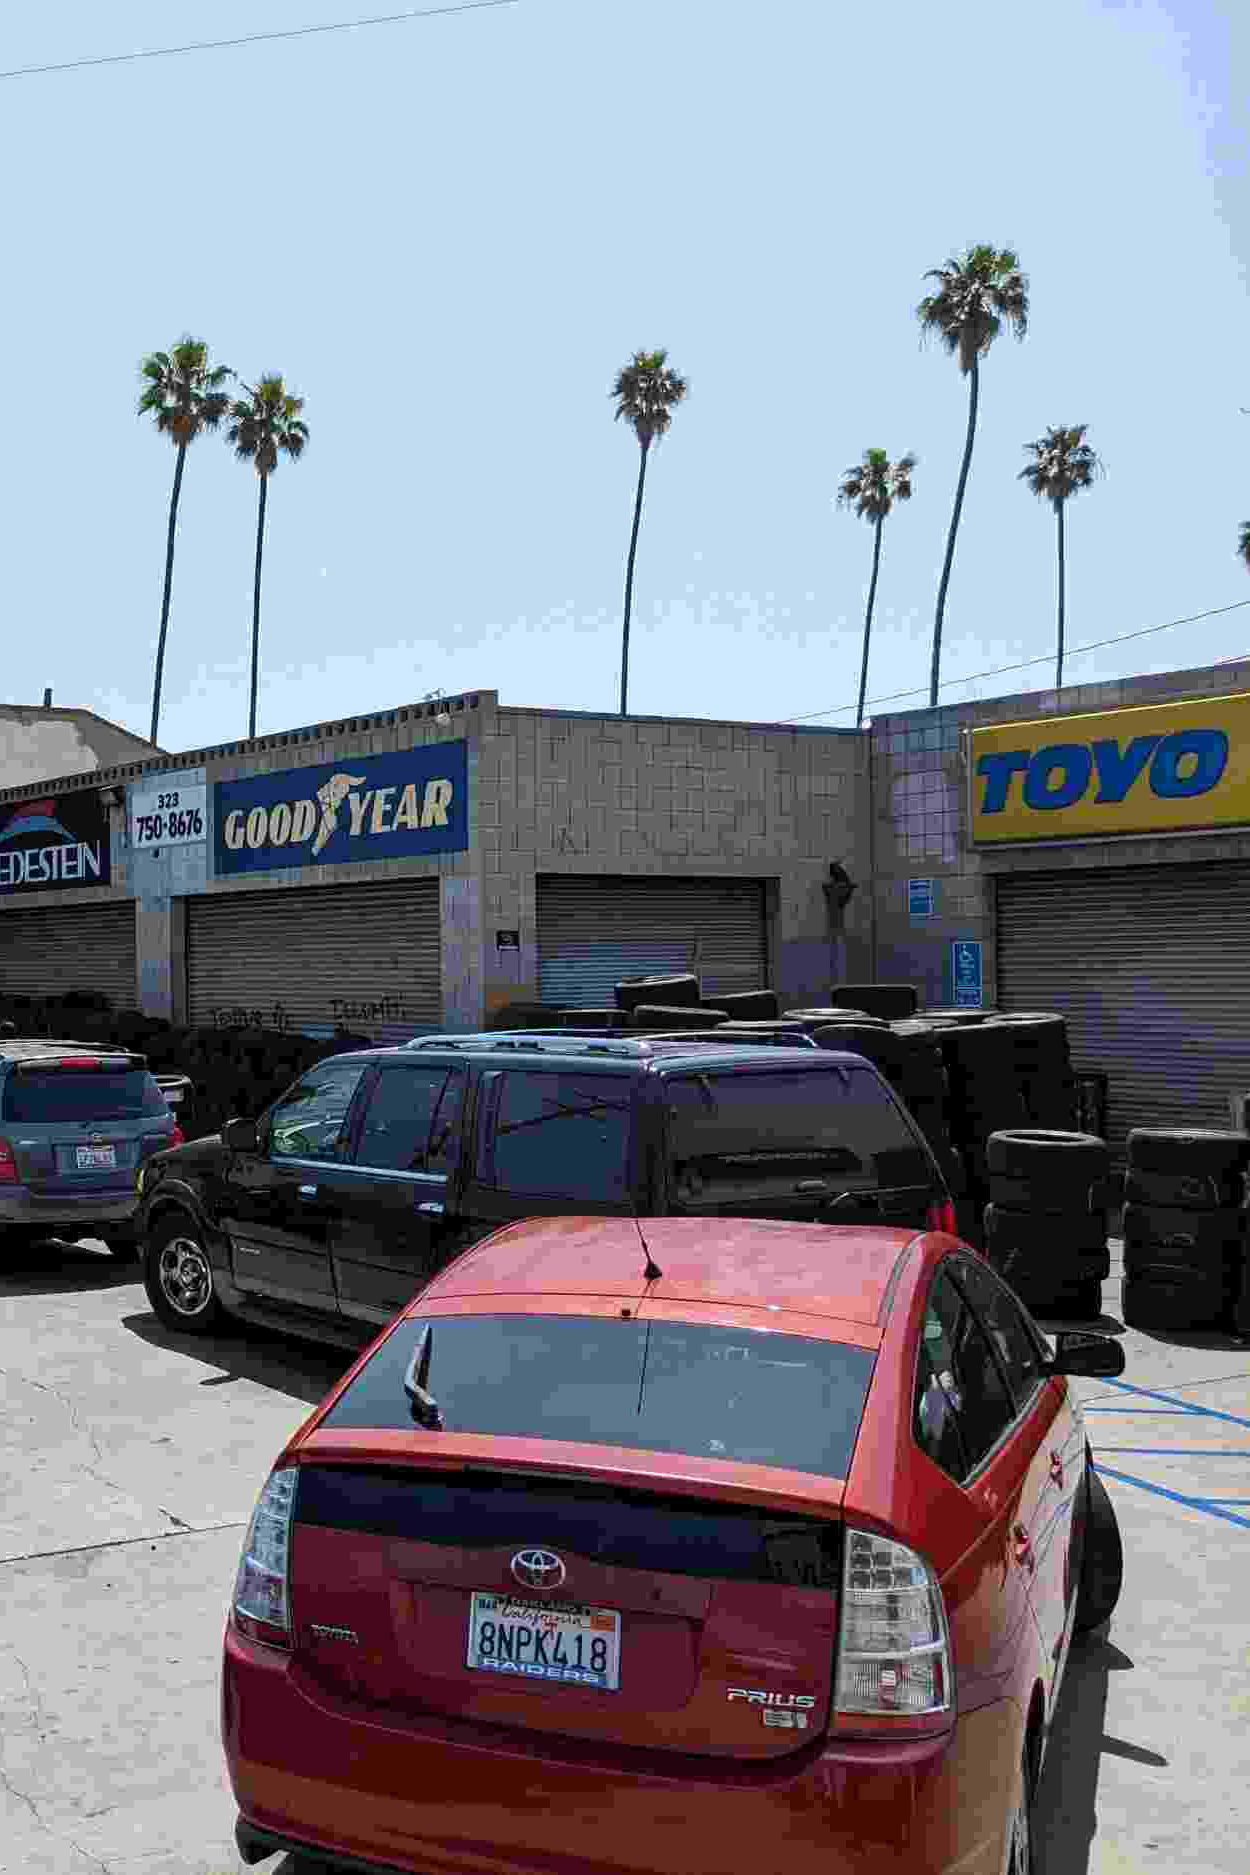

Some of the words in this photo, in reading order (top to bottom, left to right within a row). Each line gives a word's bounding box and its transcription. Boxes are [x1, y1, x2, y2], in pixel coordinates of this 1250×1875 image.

[975, 728, 1230, 816] TOYO
[158, 792, 180, 809] 323
[479, 1620, 607, 1674] 8NPK418
[482, 1656, 602, 1683] RAIDERS
[727, 1687, 816, 1709] PRIUS
